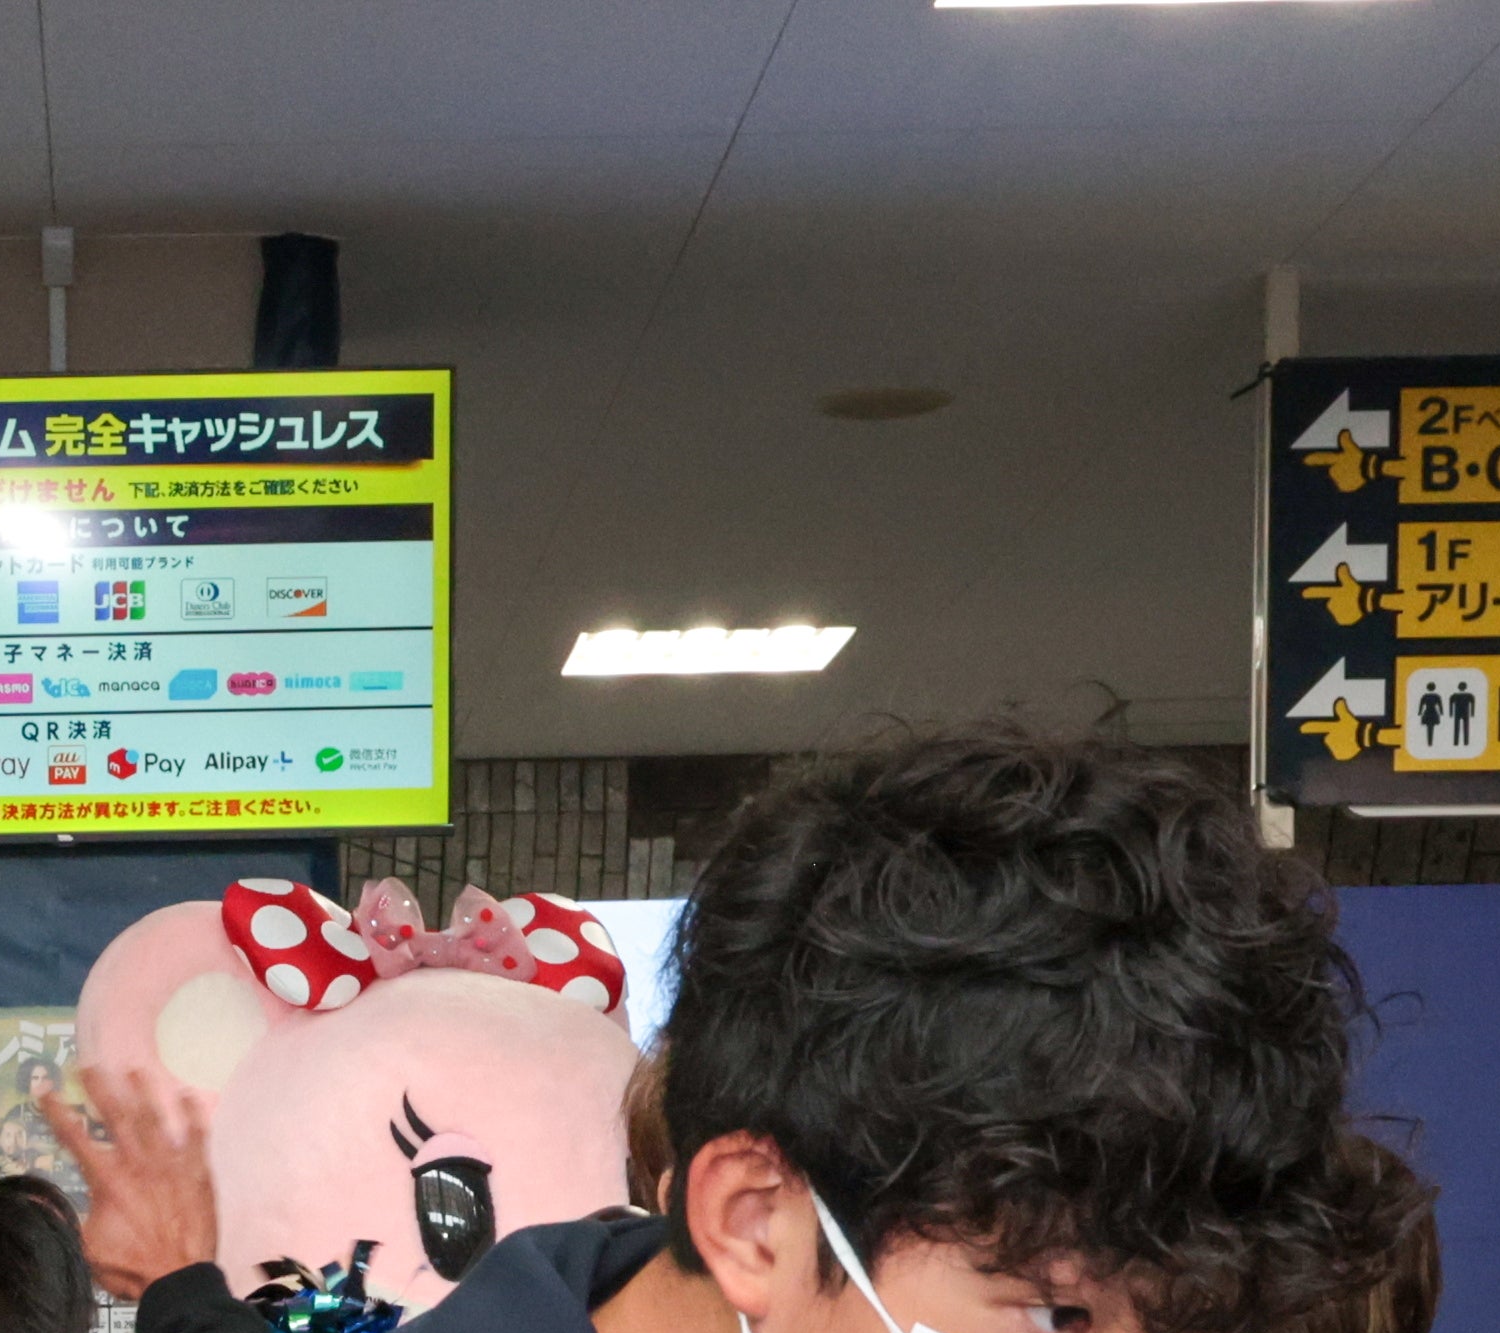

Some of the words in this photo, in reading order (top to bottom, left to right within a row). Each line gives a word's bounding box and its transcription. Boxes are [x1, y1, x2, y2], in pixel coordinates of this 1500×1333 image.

[129, 478, 359, 500] 下記、決済方法をご確認ください
[1417, 530, 1471, 571] 1F
[91, 555, 195, 571] 利用可能ブランド
[95, 593, 144, 608] JCB
[269, 588, 323, 599] DISCOVER
[99, 679, 160, 693] manaca
[285, 674, 341, 689] nimoca
[21, 720, 112, 742] QR決済
[53, 752, 79, 764] au
[144, 753, 185, 777] Pay
[55, 767, 80, 781] PAY
